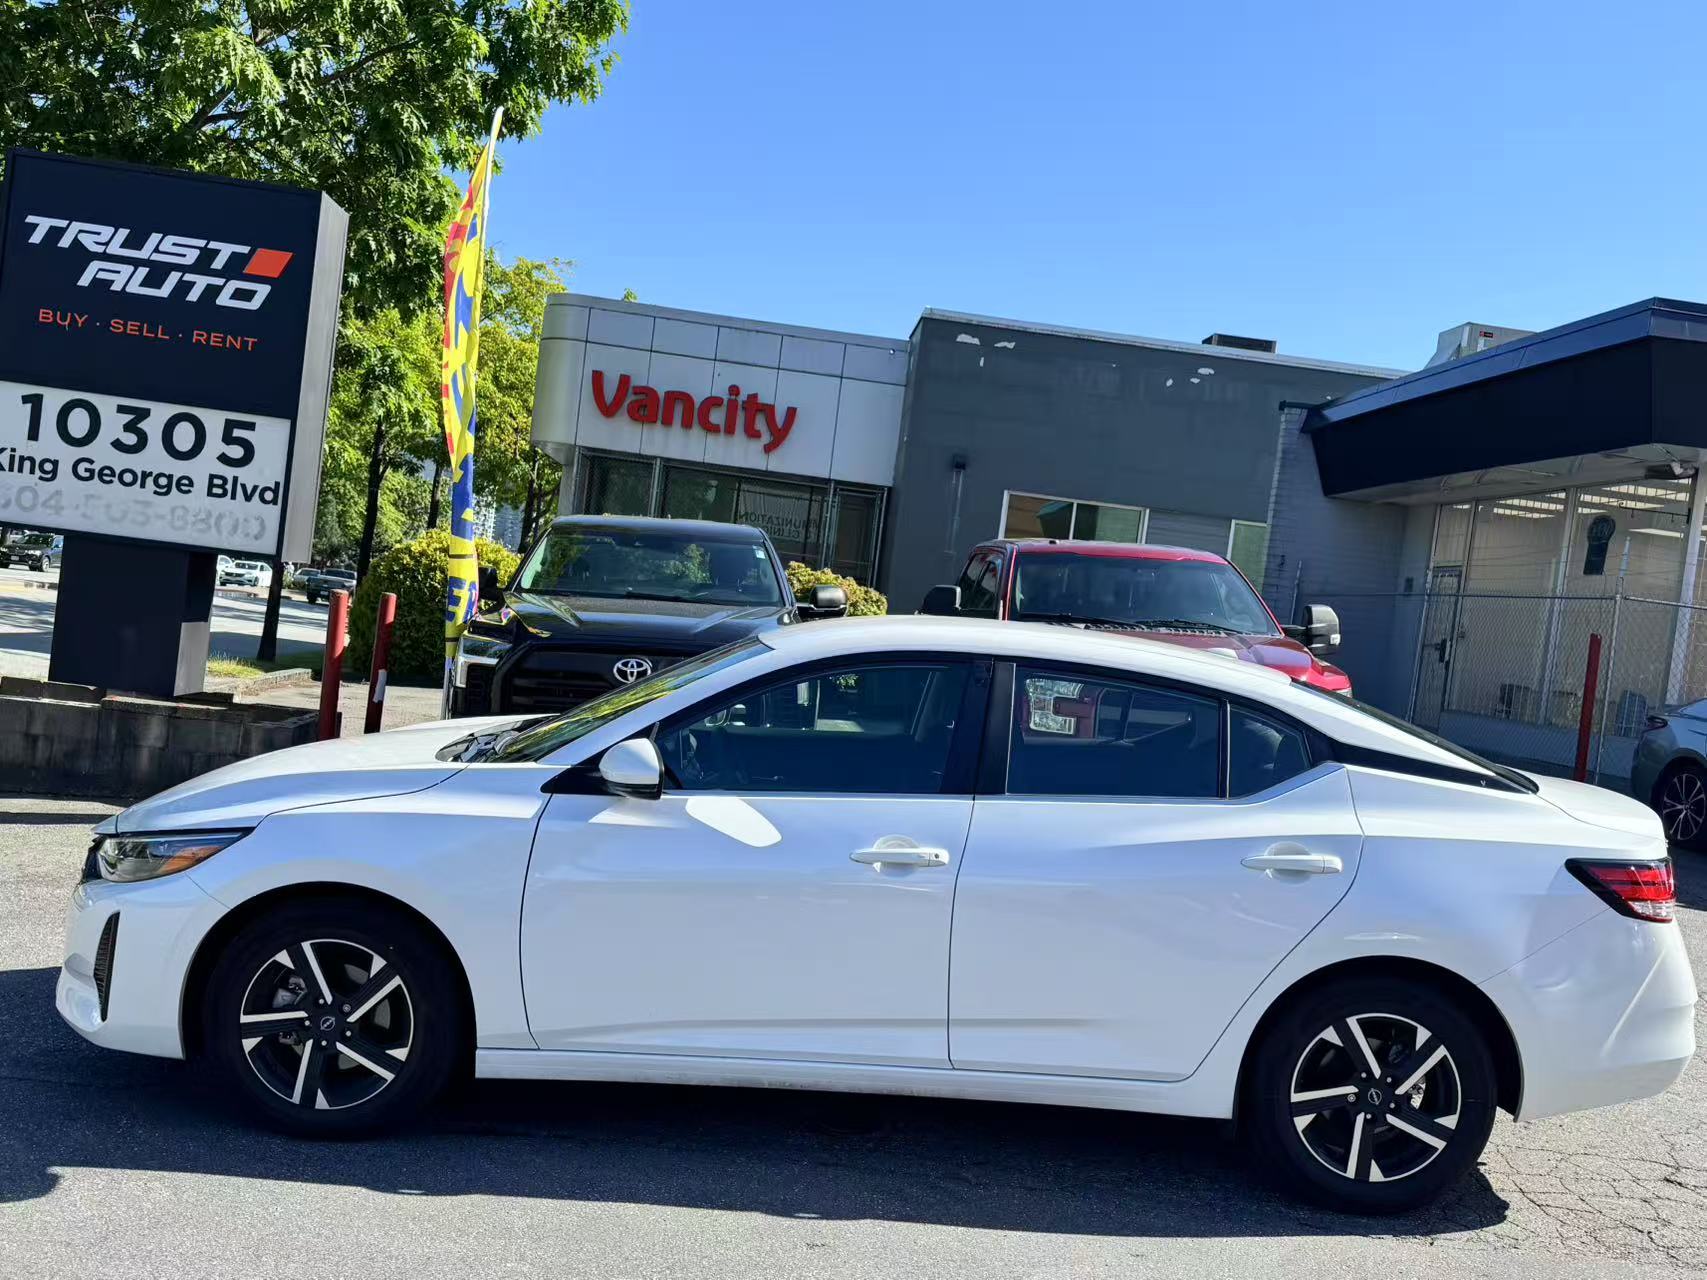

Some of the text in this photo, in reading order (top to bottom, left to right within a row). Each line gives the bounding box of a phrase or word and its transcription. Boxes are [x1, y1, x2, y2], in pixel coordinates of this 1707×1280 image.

[25, 215, 251, 270] TRUST
[77, 260, 271, 311] AUTO
[38, 309, 258, 351] BUY SELL RENT
[21, 393, 257, 468] 10305
[591, 370, 797, 453] Vancity
[72, 457, 194, 496] George
[206, 473, 281, 505] Blvd
